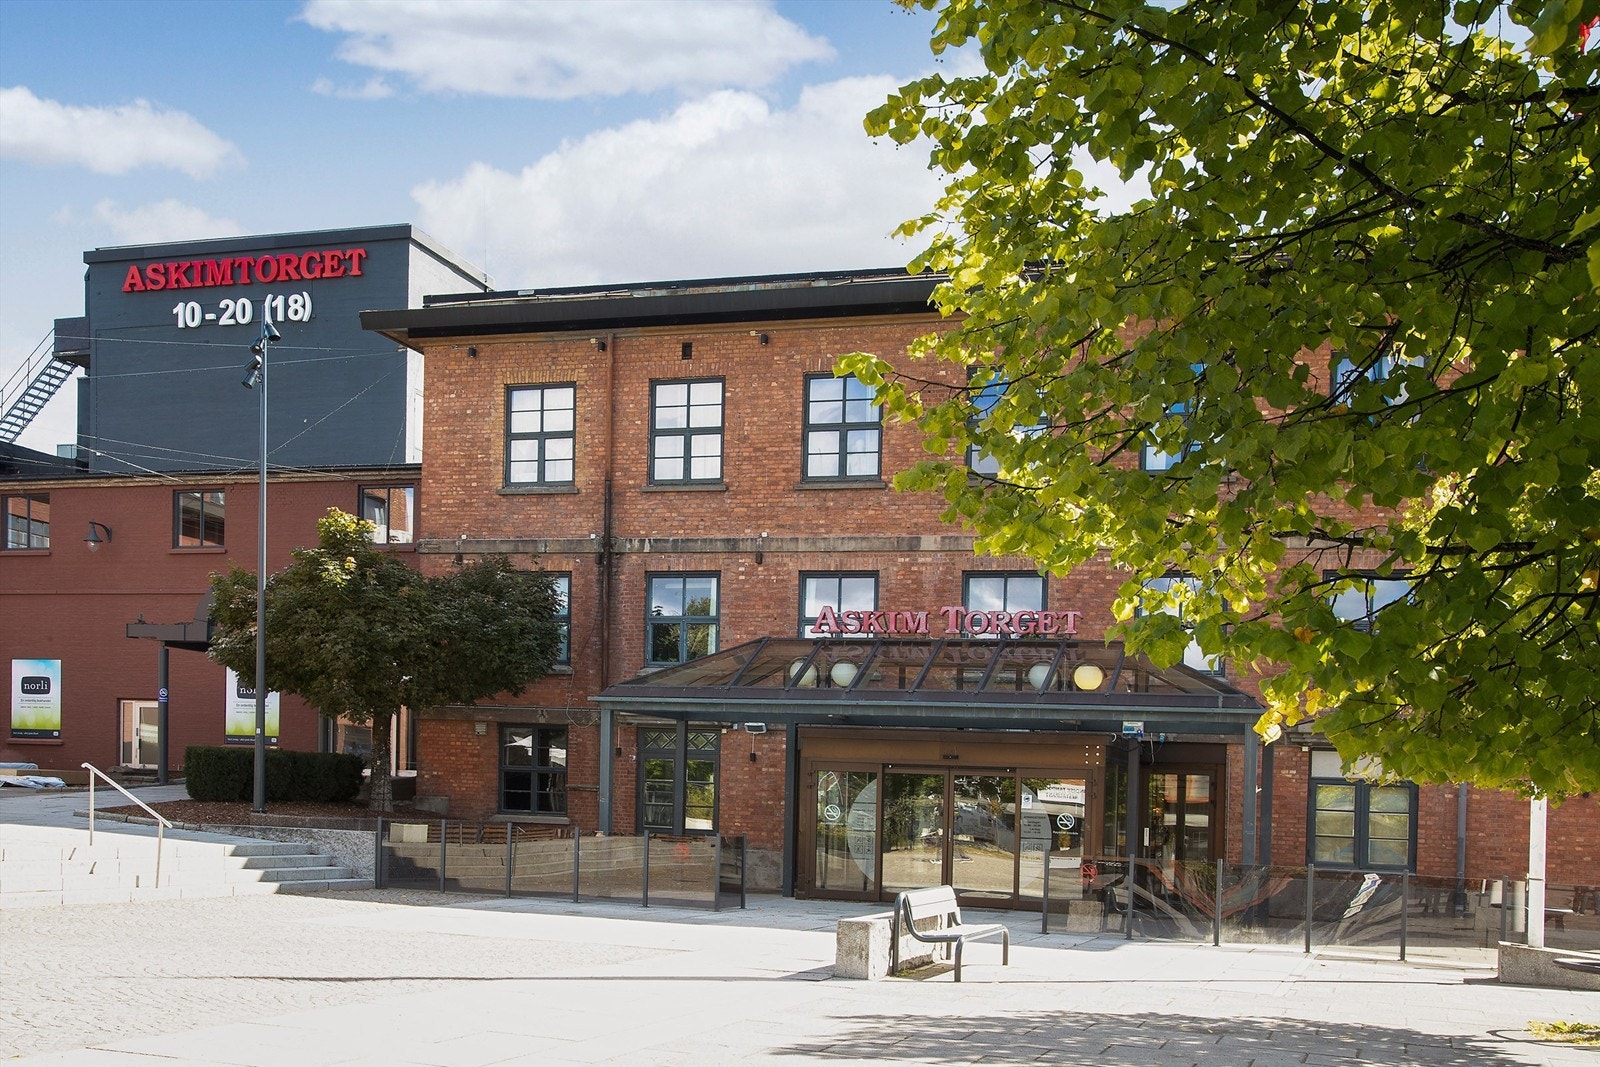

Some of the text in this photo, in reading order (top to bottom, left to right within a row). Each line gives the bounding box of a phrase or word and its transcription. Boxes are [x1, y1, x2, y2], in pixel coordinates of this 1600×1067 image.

[122, 248, 367, 292] ASKIMTORGET
[172, 291, 313, 328] 10-20 (18)
[810, 605, 1083, 635] ASKIM TORGET
[24, 680, 48, 690] norli
